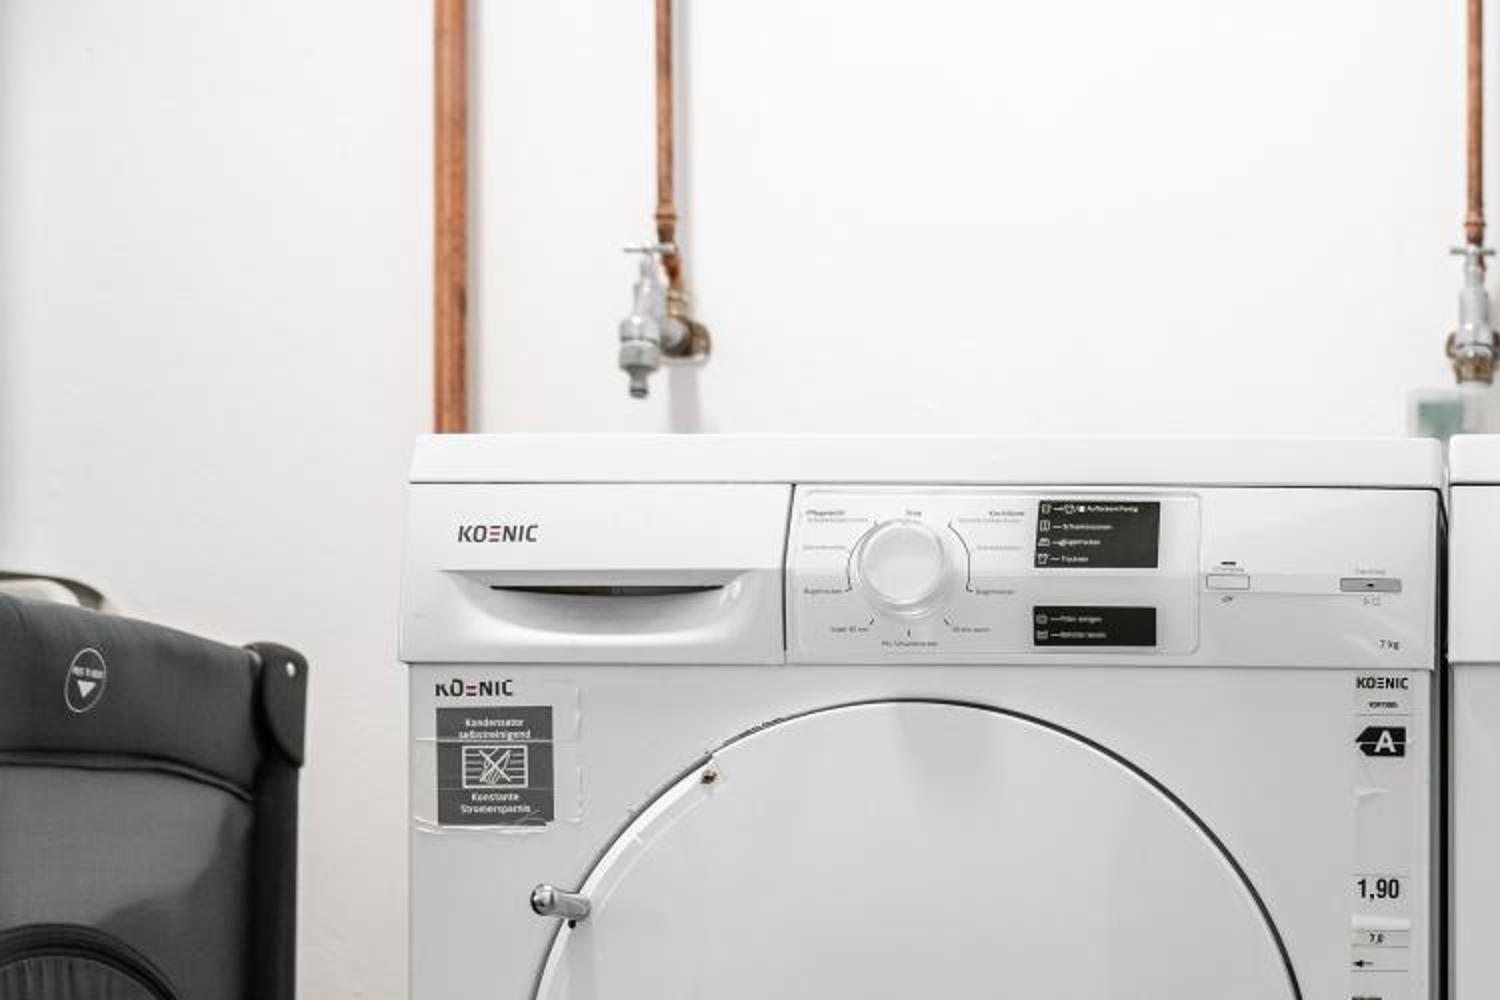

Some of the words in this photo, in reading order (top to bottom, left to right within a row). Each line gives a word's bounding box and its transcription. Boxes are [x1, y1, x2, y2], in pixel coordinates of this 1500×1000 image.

[457, 525, 539, 543] KOENIC
[435, 679, 514, 697] KOENIC
[1356, 676, 1409, 690] KOENIC
[1373, 730, 1397, 753] A
[1357, 877, 1400, 900] 1,90
